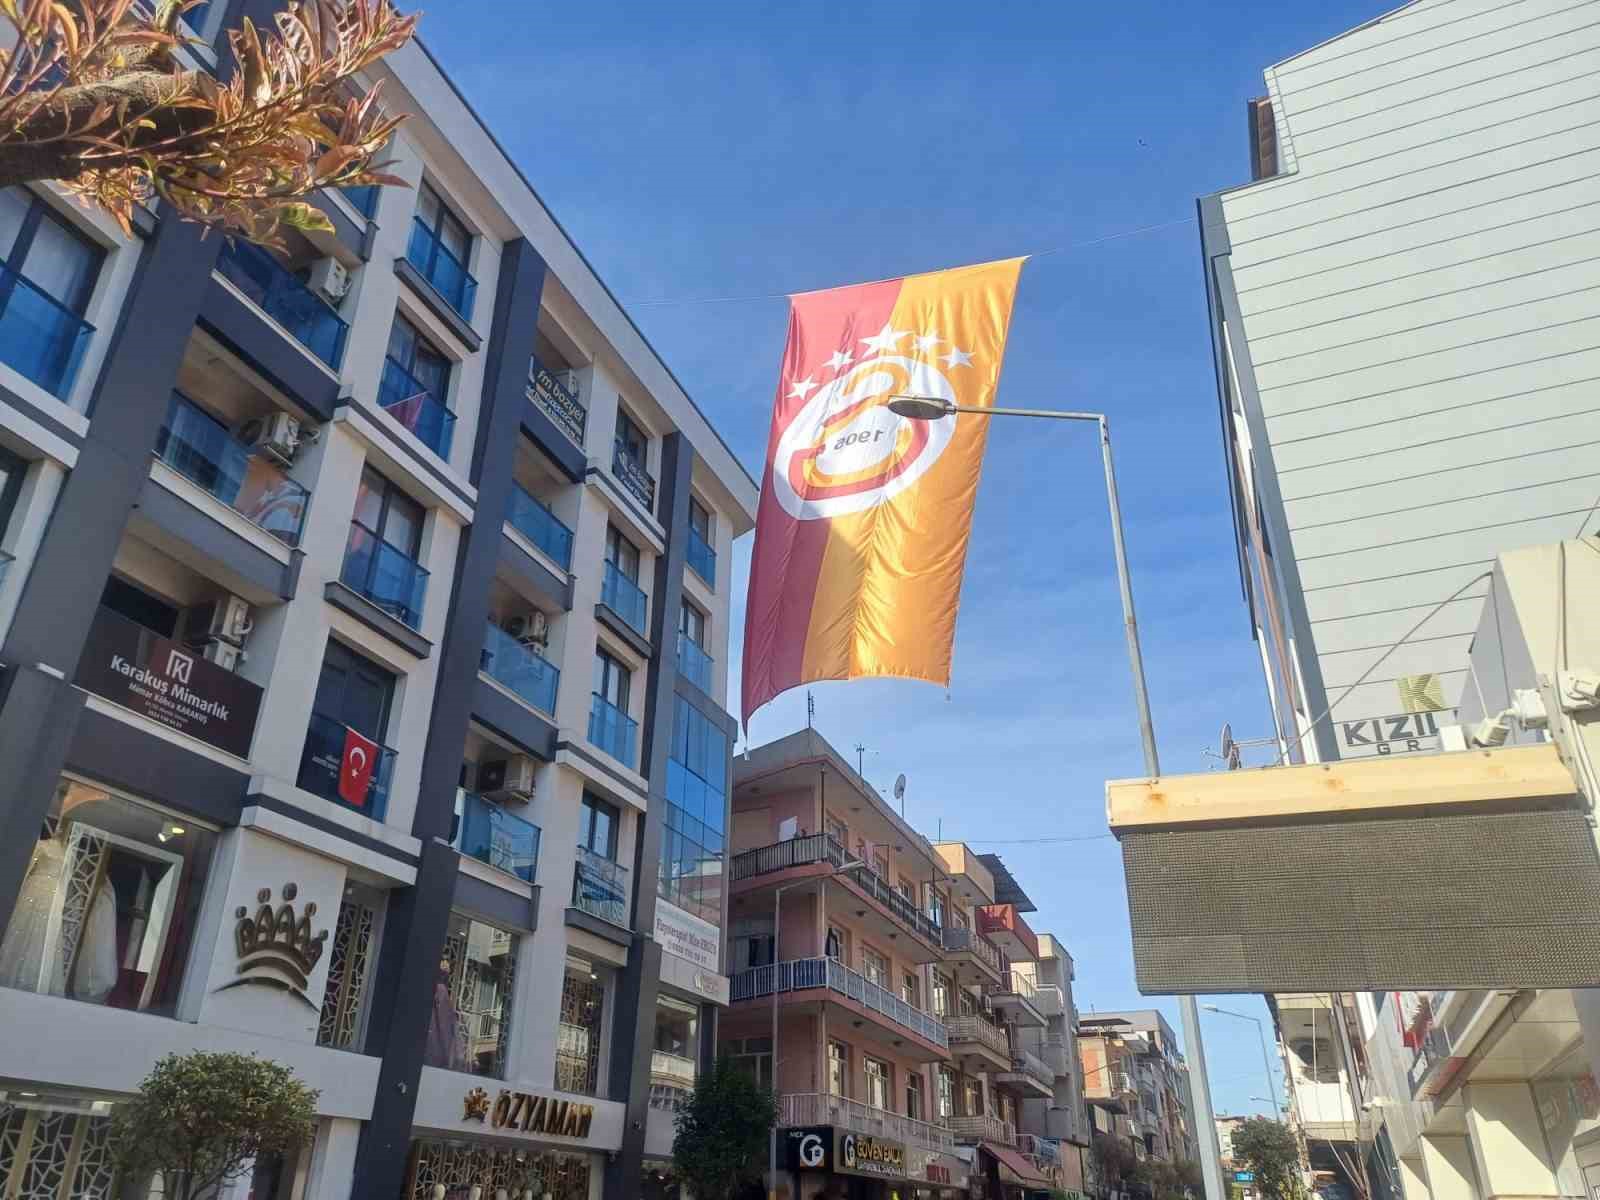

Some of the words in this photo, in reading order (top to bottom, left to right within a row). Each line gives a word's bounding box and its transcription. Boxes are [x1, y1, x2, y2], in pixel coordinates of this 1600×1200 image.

[110, 655, 169, 694] Karakuş
[170, 683, 230, 721] Mimarlık
[492, 1088, 592, 1138] ÖZYAMAN
